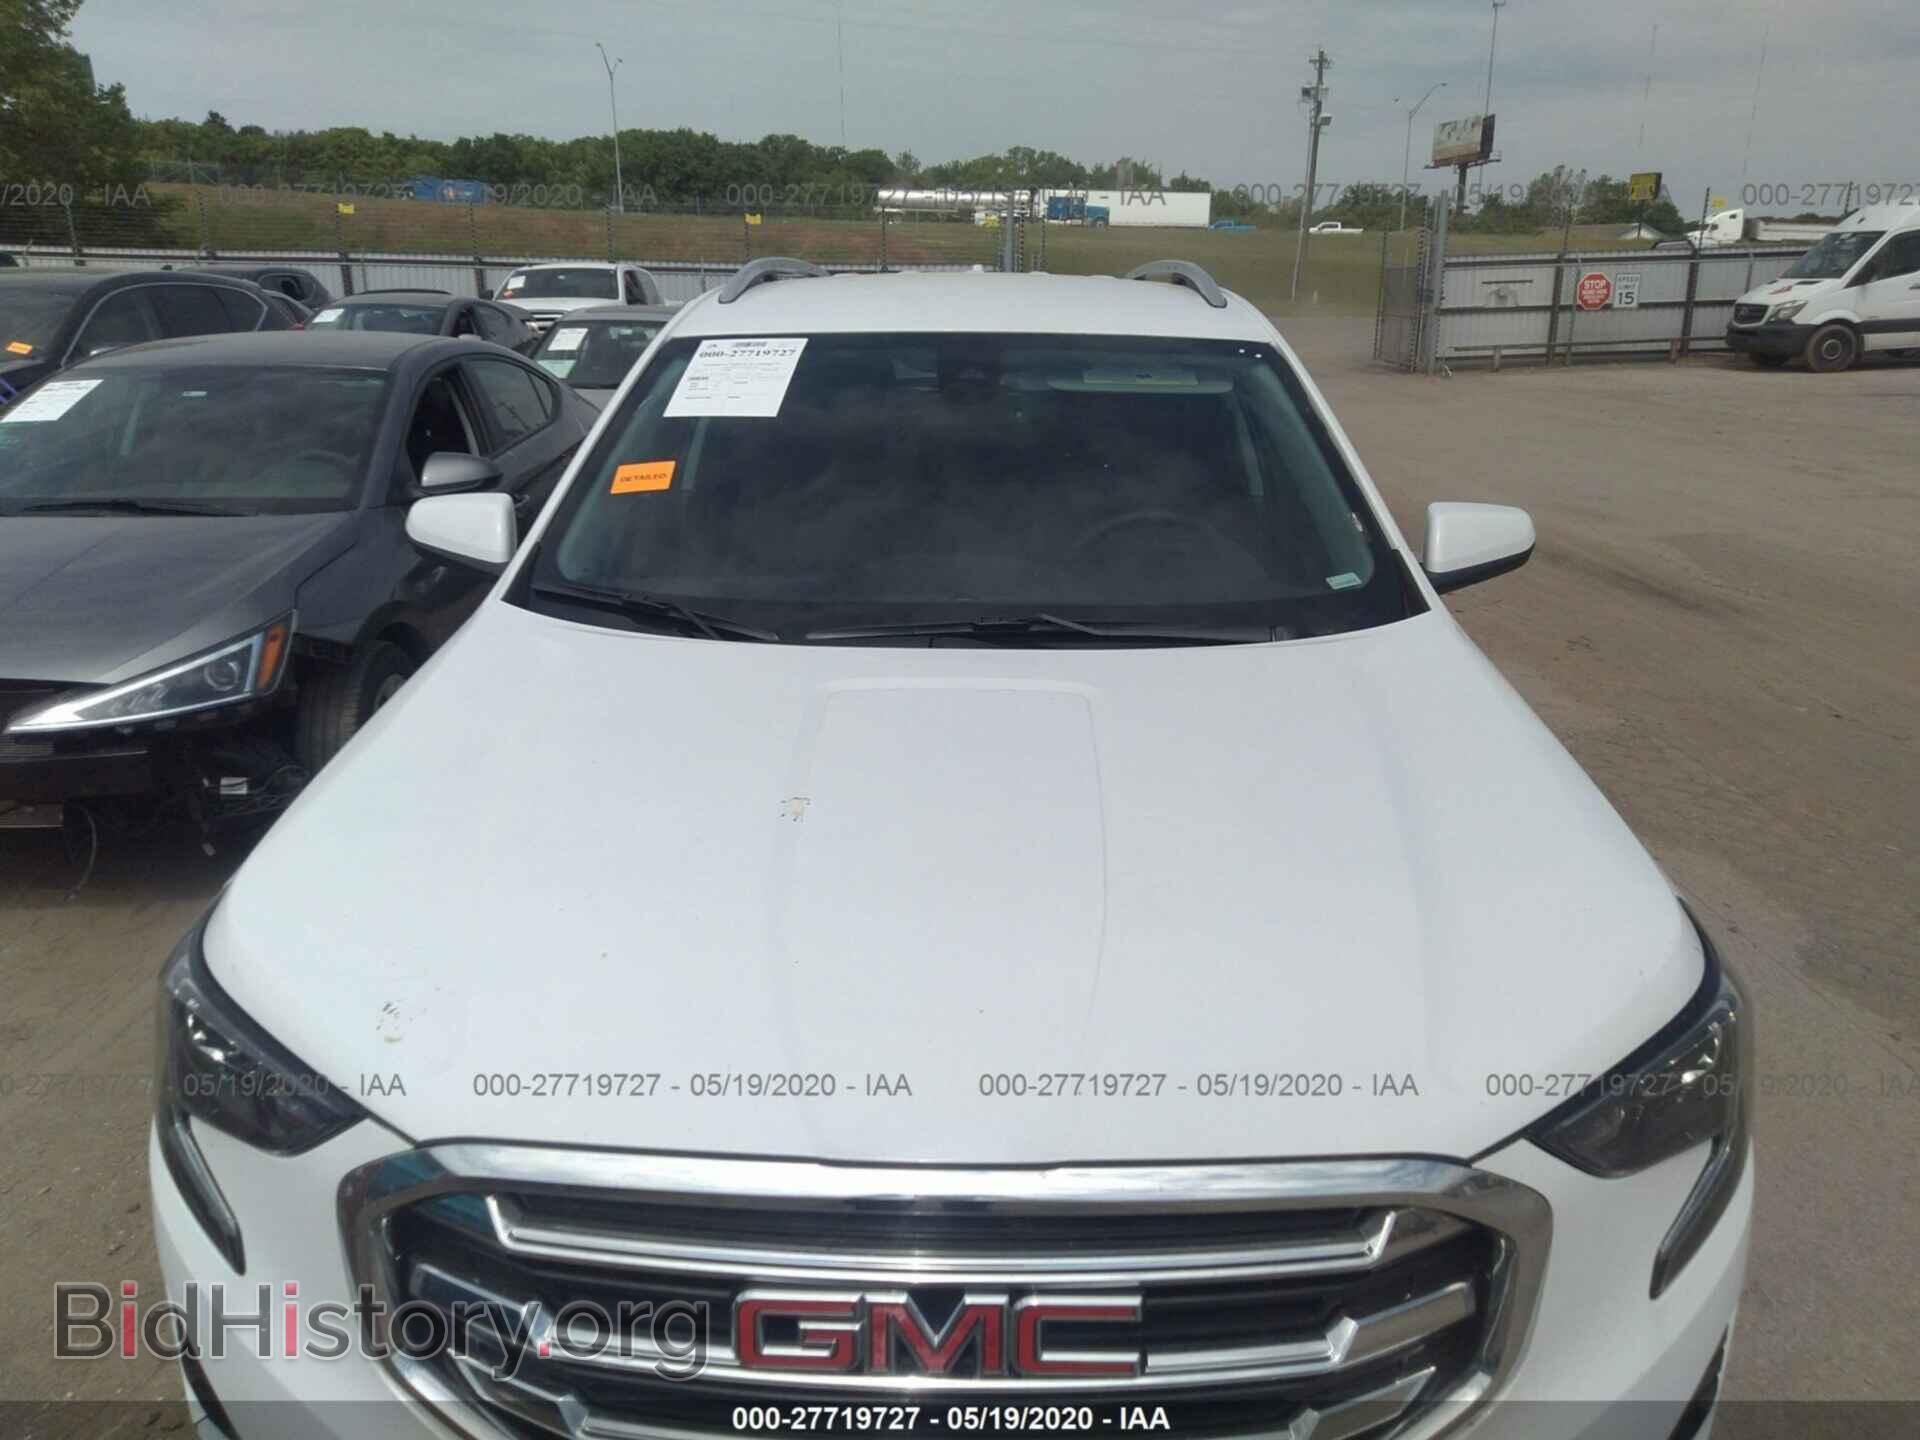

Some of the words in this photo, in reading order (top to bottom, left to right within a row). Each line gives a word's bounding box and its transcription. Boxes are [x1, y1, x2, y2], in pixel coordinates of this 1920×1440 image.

[1584, 280, 1607, 289] STOP
[1618, 291, 1635, 305] 15
[700, 349, 798, 359] 000-27719727
[732, 1289, 1144, 1377] GMC
